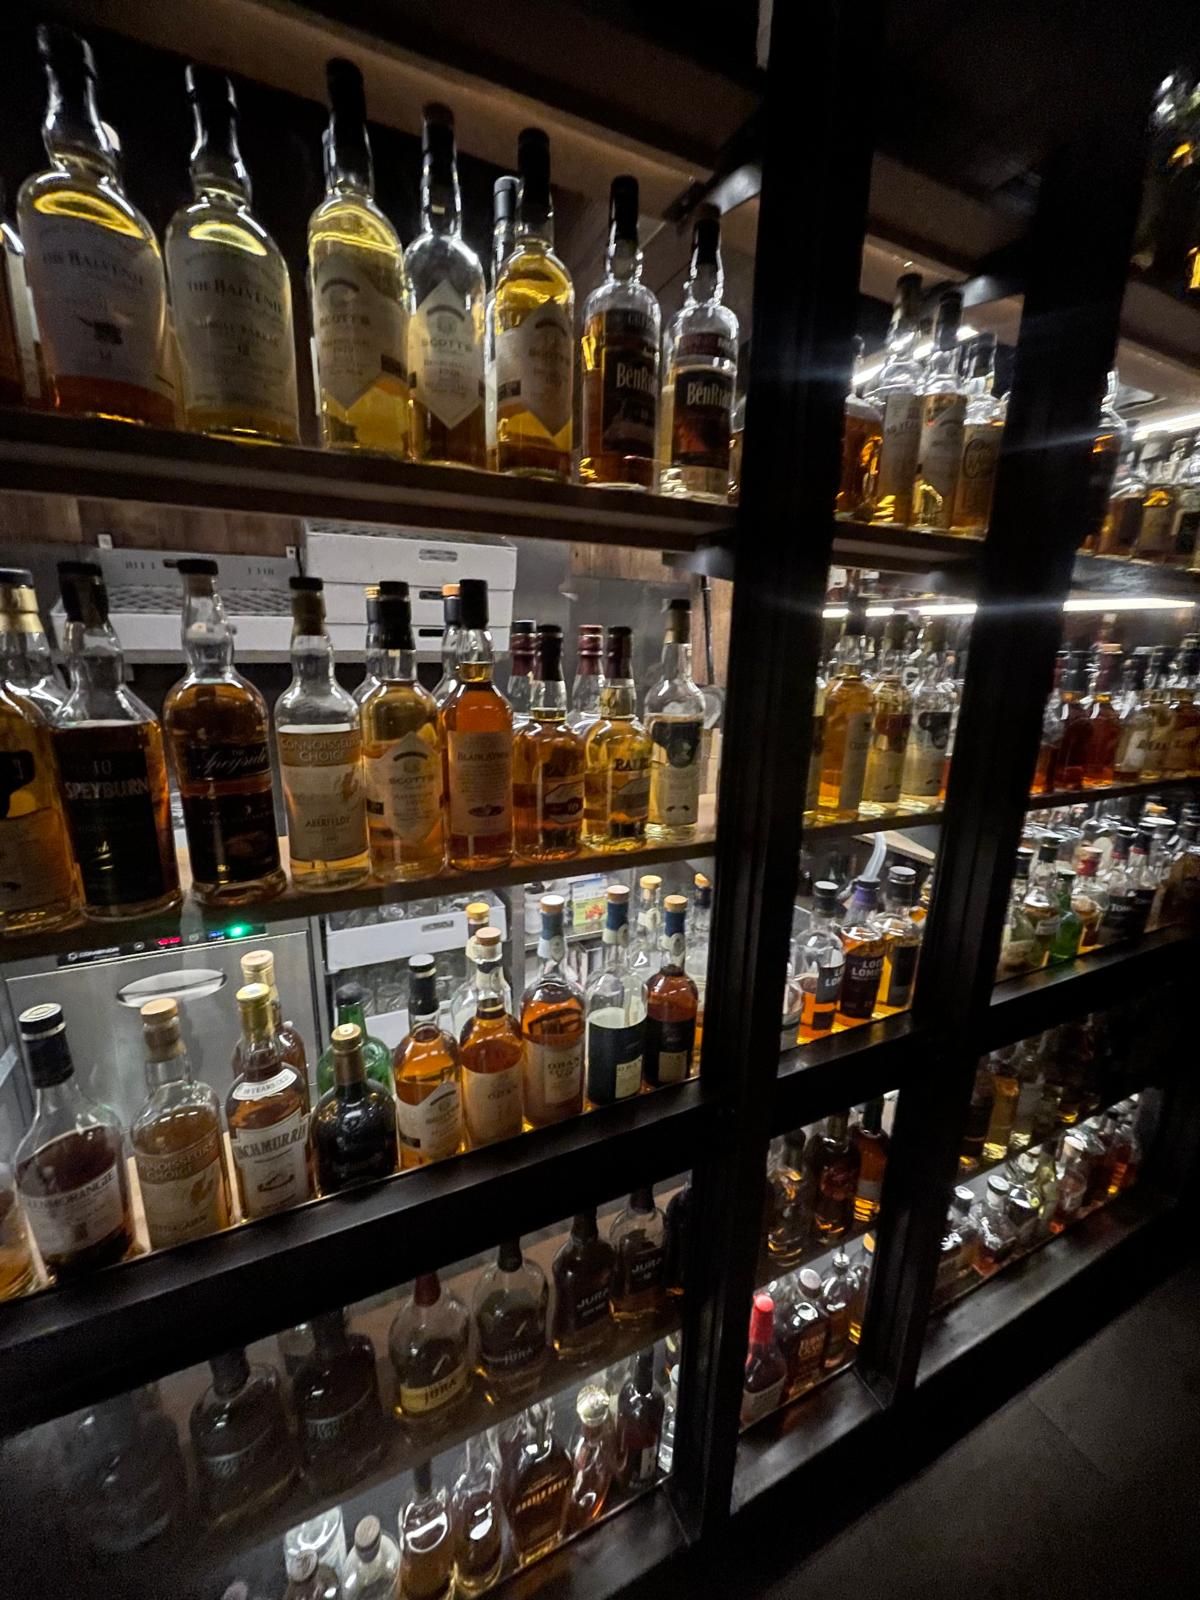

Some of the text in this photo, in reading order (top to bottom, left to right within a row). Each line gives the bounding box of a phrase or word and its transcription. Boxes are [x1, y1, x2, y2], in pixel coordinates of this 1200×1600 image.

[63, 776, 150, 801] SPEYBURN
[631, 1256, 663, 1274] JURA
[575, 1286, 609, 1309] JURA
[424, 1377, 457, 1407] JURA
